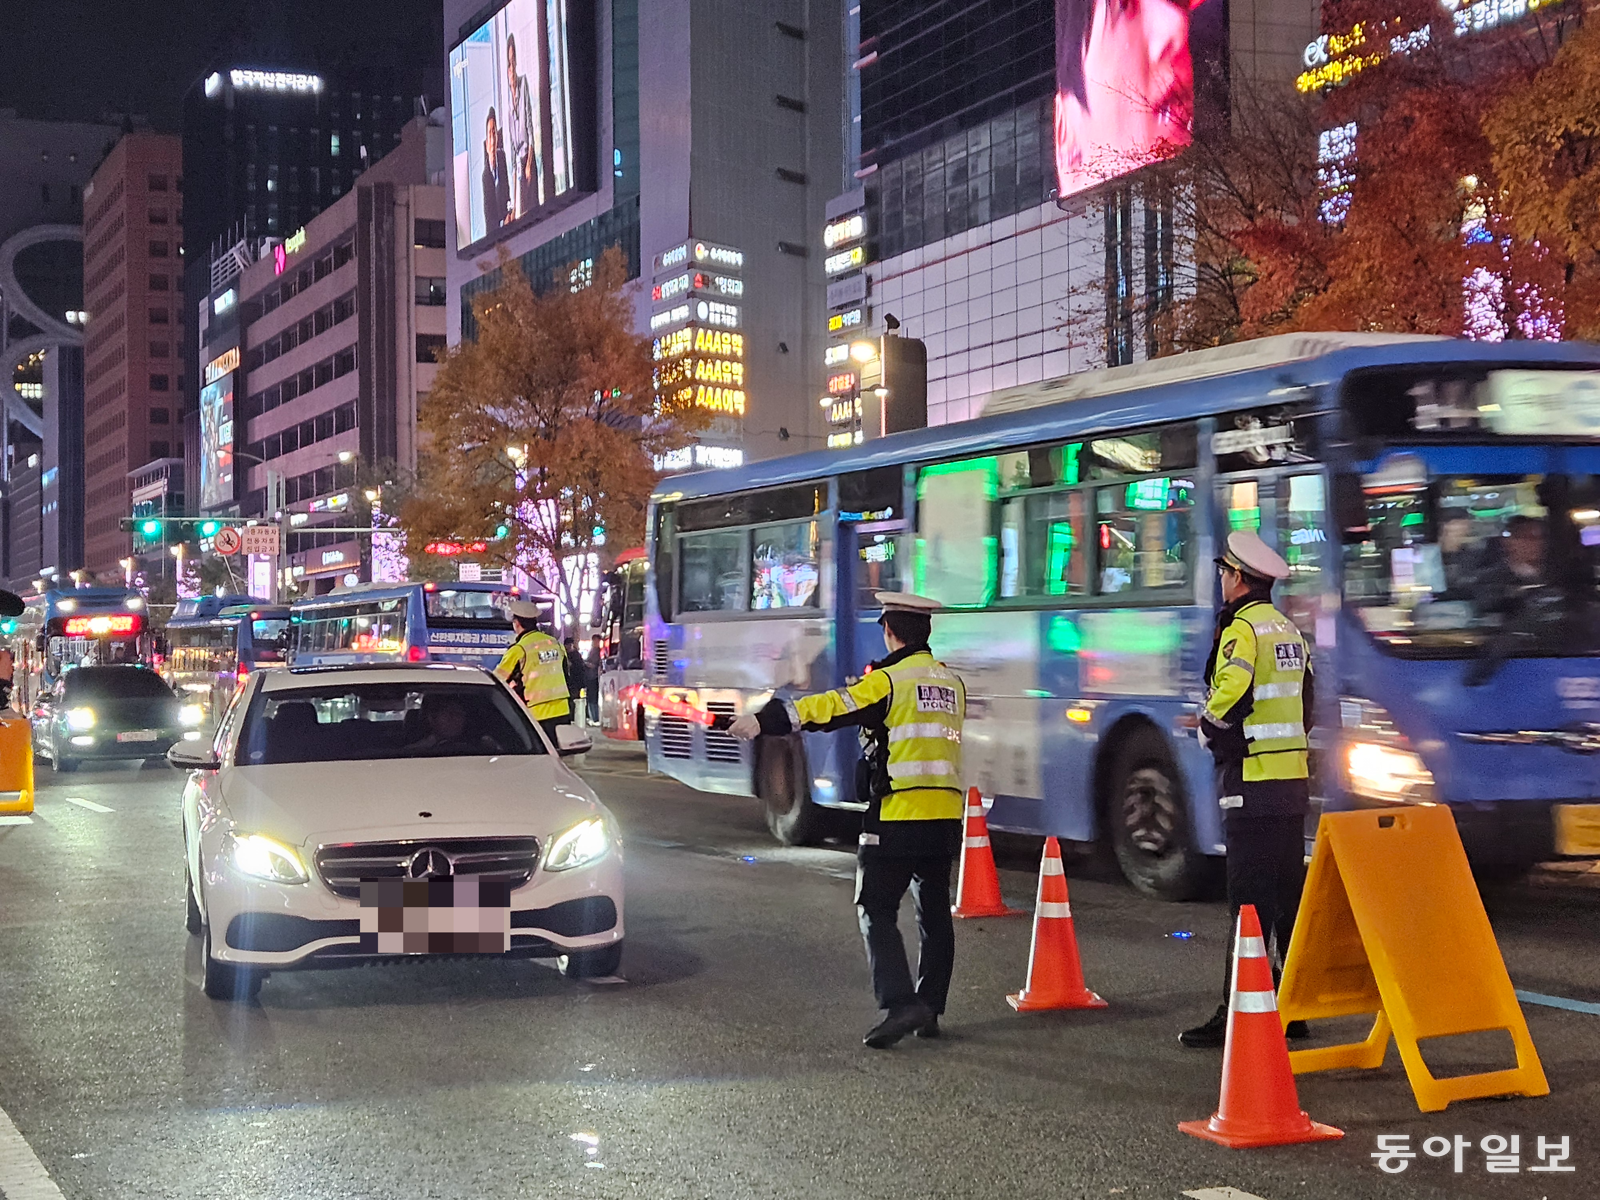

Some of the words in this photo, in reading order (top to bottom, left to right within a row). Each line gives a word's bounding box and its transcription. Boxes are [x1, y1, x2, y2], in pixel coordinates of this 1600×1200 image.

[230, 69, 319, 91] 한국자산관리공사
[430, 632, 480, 644] 신한투자증권
[481, 633, 510, 645] 처음IS
